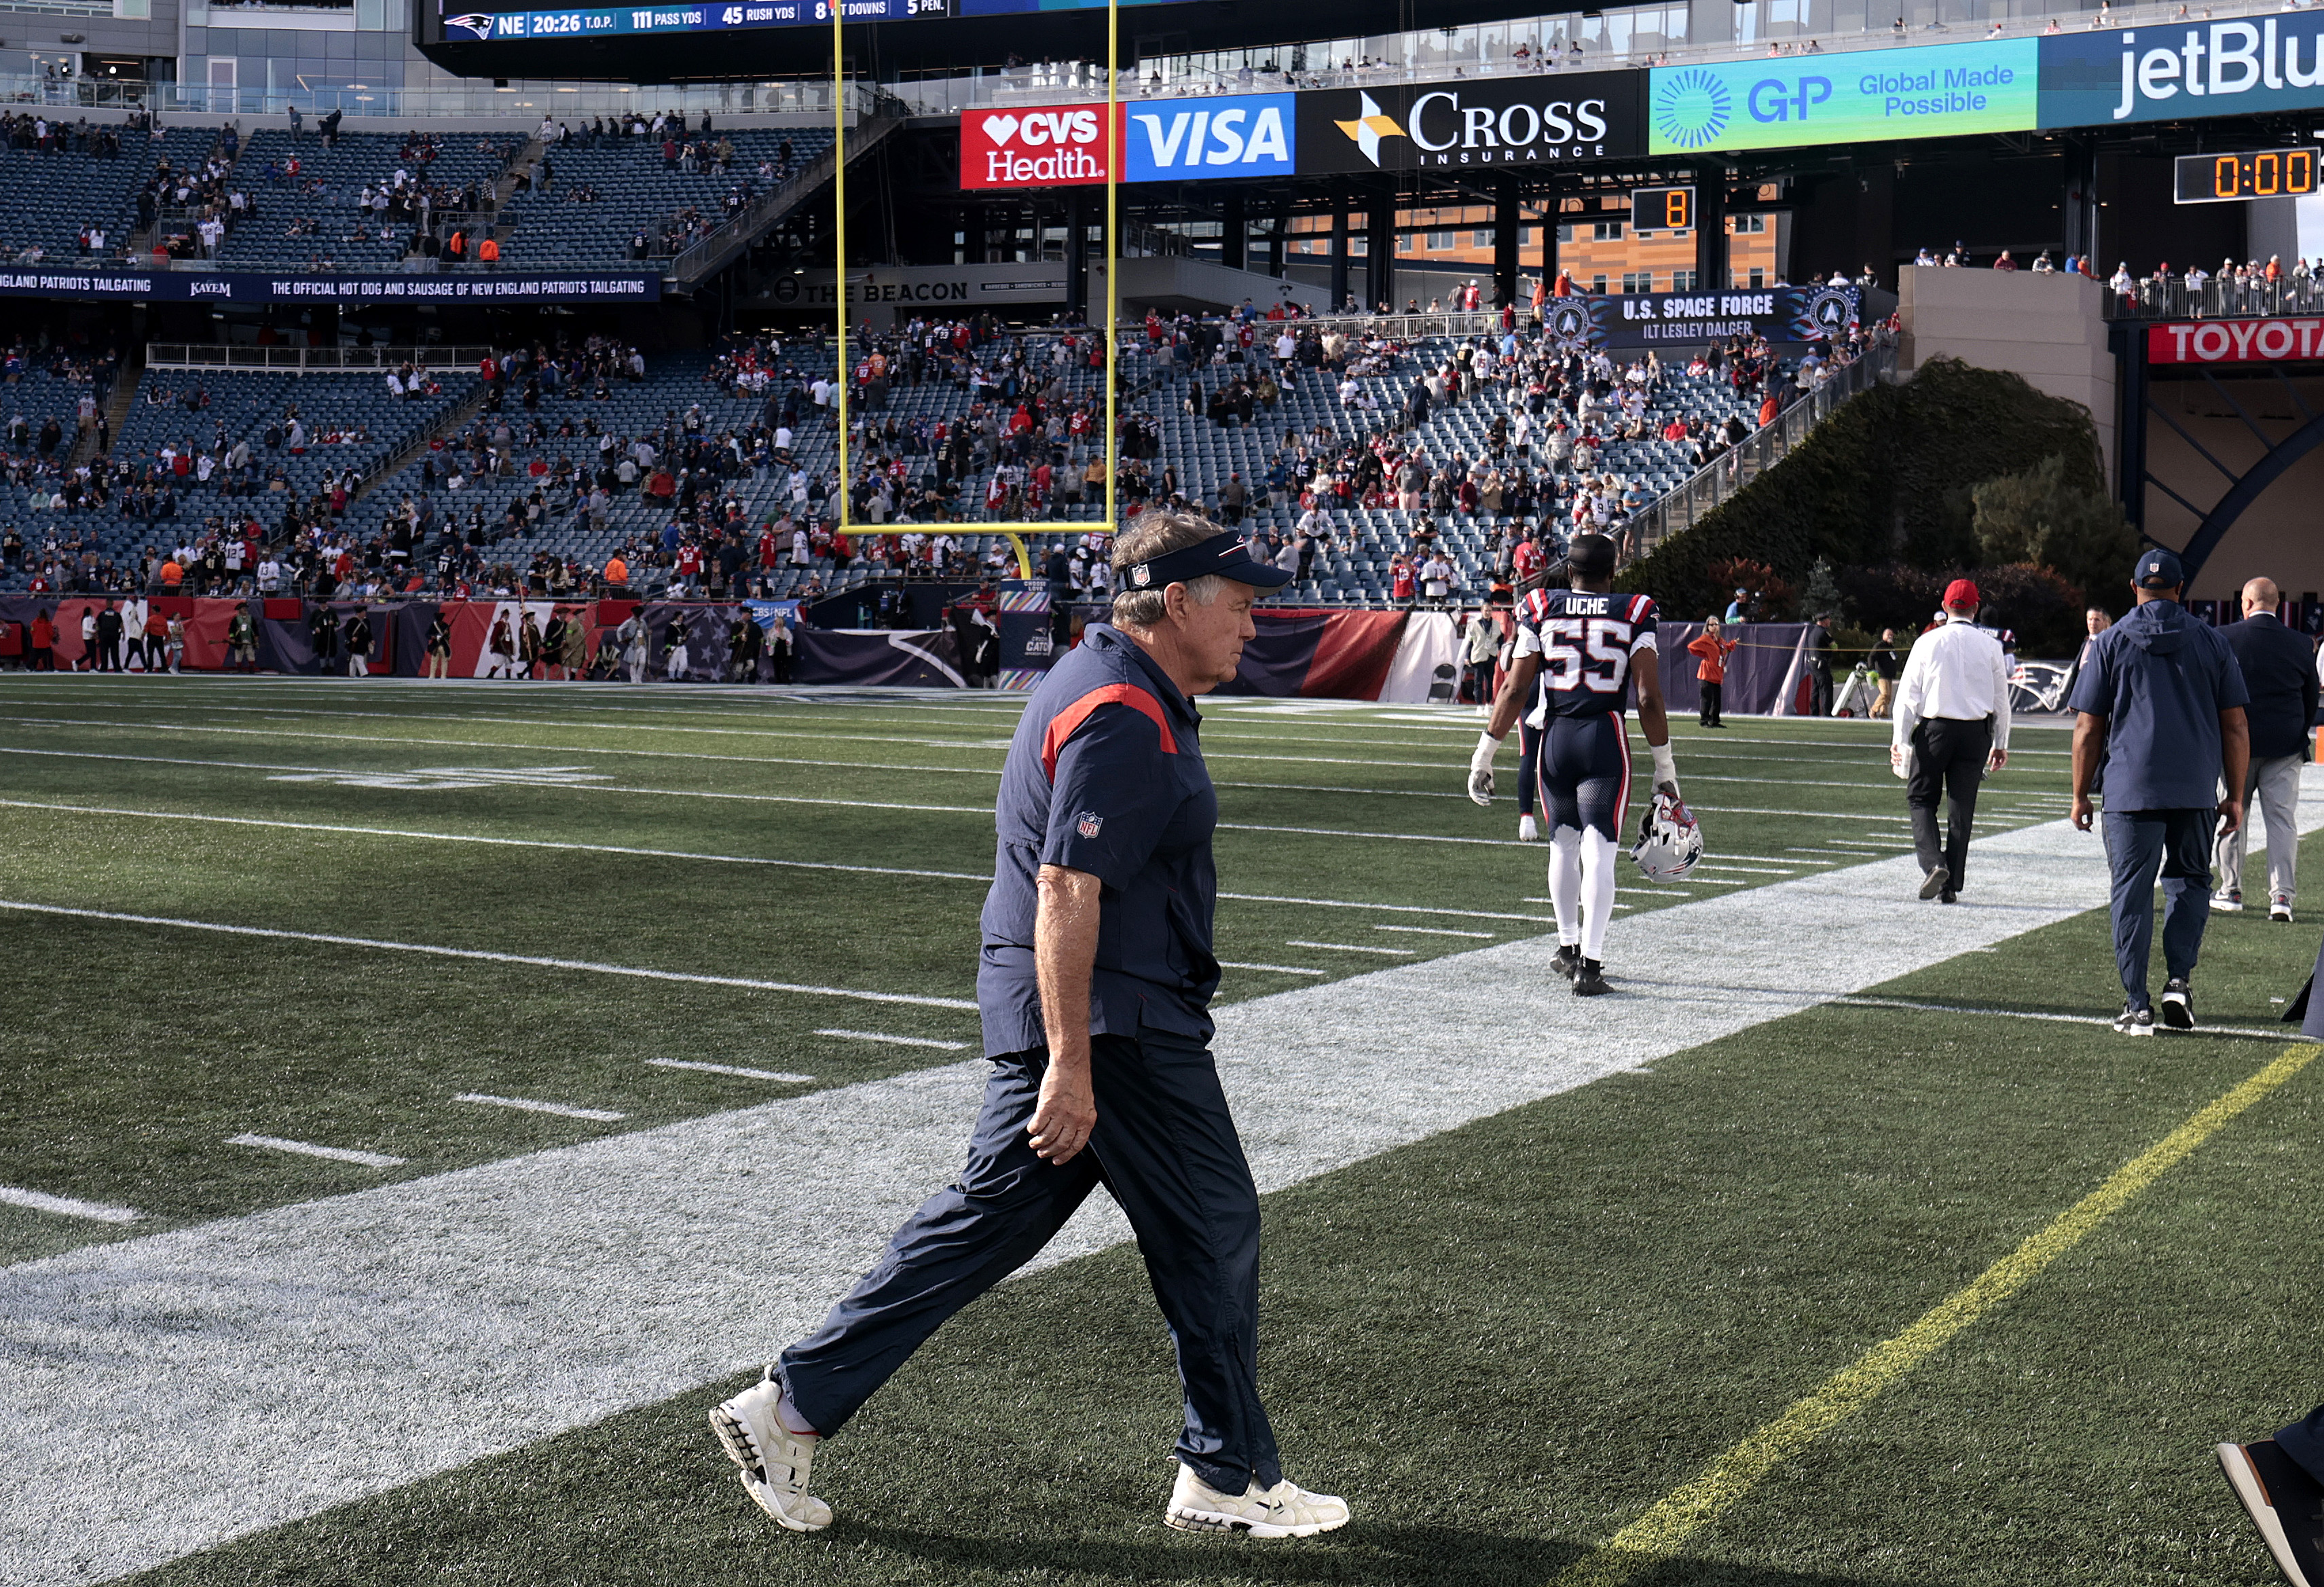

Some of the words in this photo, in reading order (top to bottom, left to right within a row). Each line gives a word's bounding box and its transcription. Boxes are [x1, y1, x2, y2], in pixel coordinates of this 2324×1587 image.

[498, 16, 525, 35] NE
[533, 15, 581, 33] 20:26
[585, 17, 613, 30] T.O.P.
[631, 12, 652, 29] 111
[654, 14, 680, 26] PASS
[682, 12, 702, 24] YDS
[722, 7, 743, 24] 45
[746, 9, 773, 22] RUSH
[775, 7, 795, 20] YDS
[815, 2, 826, 20] 8
[849, 1, 886, 16] DOWNS
[907, 0, 918, 15] 5
[921, 0, 944, 12] PEN.
[1859, 69, 1936, 96] Global
[1944, 65, 2014, 89] Made
[2113, 18, 2324, 120] jetBlu
[1885, 90, 1987, 117] Possible
[1020, 110, 1099, 146] CVS
[1408, 91, 1607, 152] CROSS
[1132, 107, 1289, 168] VISA
[986, 147, 1097, 182] Health
[1420, 145, 1604, 166] INSURANCE
[2215, 151, 2310, 197] 0:00
[1666, 190, 1687, 228] 8
[40, 276, 90, 291] PATRIOTS
[92, 277, 151, 292] TAILGATING
[190, 282, 232, 297] KAYEM
[272, 282, 291, 295] THE
[293, 282, 337, 295] OFFICIAL
[339, 282, 358, 295] HOT
[361, 282, 382, 295] DOG
[384, 282, 405, 295] AND
[407, 282, 454, 295] SAUSAGE
[456, 282, 470, 295] OF
[472, 282, 494, 295] NEW
[496, 281, 540, 295] ENGLAND
[541, 280, 588, 294] PATRIOTS
[589, 280, 644, 294] TAILGATING
[805, 285, 854, 304] THE
[864, 282, 967, 303] BEACON
[1623, 299, 1657, 321] U.S.
[1663, 297, 1715, 319] SPACE
[1721, 294, 1773, 316] FORCE
[940, 331, 948, 339] 23
[1663, 323, 1703, 339] LESLEY
[2169, 321, 2324, 361] TOYOT
[1295, 465, 1309, 477] 45
[1598, 503, 1604, 514] 9
[227, 549, 236, 559] 12
[752, 607, 769, 617] CBS
[774, 608, 792, 617] NFL
[1566, 597, 1609, 615] UCHE
[1539, 618, 1633, 693] 55
[1080, 821, 1096, 835] NFL
